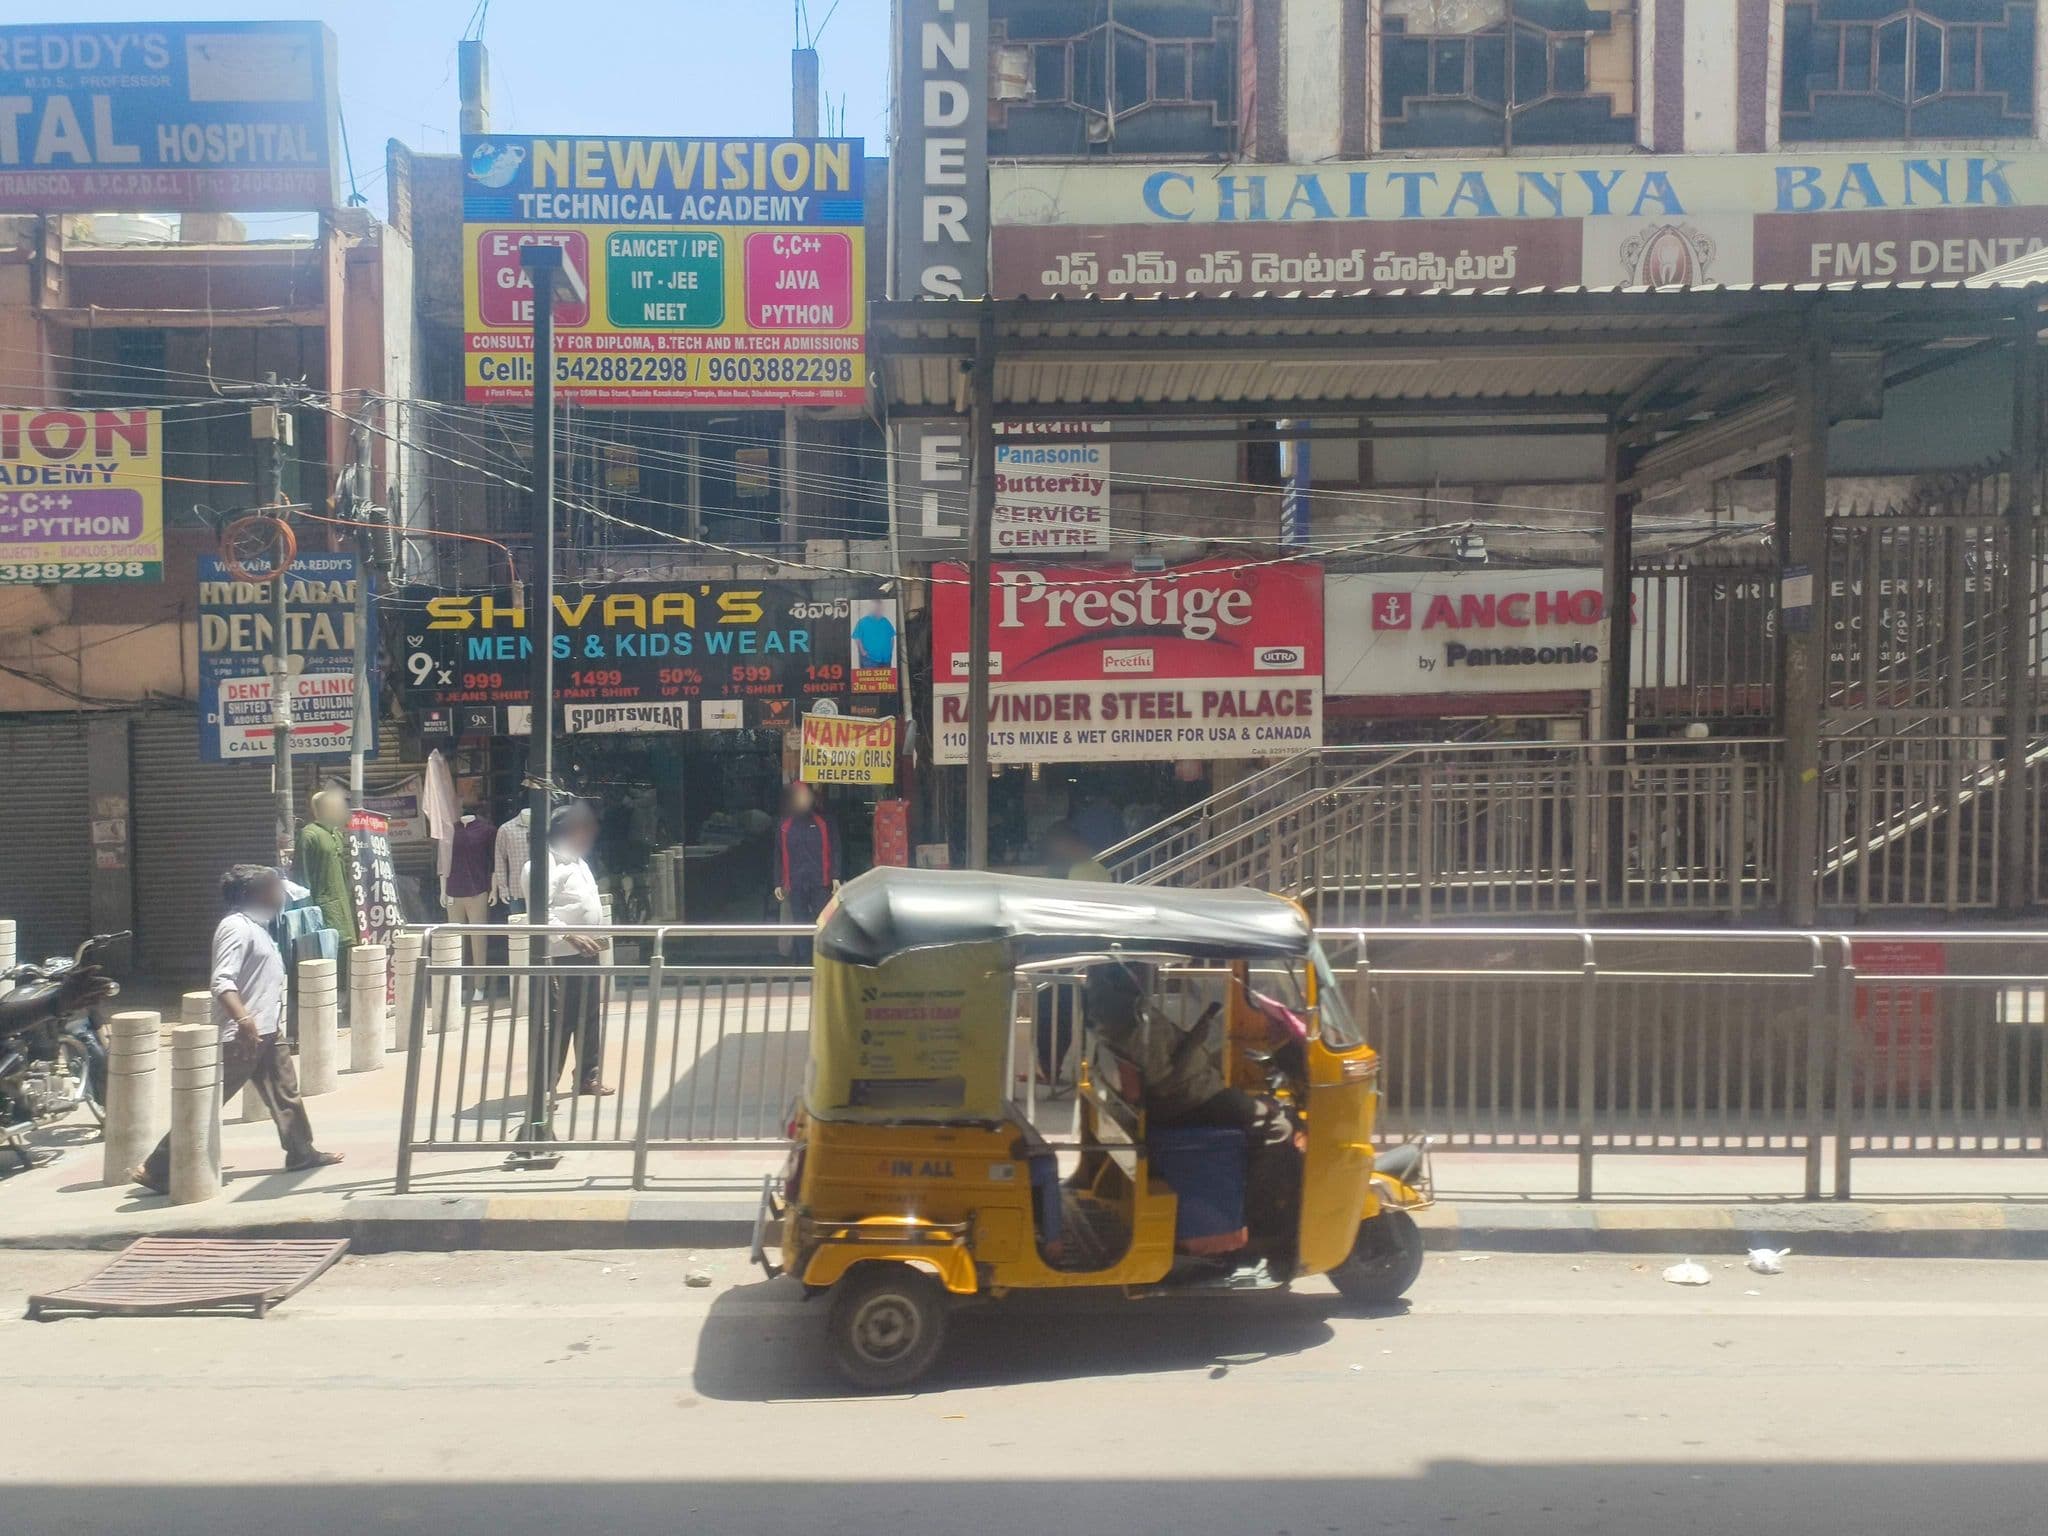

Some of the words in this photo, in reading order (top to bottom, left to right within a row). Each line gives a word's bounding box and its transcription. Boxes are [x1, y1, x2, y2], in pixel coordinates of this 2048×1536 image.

[80, 75, 172, 88] PROFESSOR
[157, 122, 318, 163] HOSPITAL
[531, 139, 852, 192] NEWVISION
[1143, 169, 1688, 222] CHAITANYA
[1773, 158, 2020, 212] BANK
[518, 193, 672, 220] TECHNICAL
[680, 195, 809, 222] ACADEMY
[610, 238, 678, 258] EAMCET
[691, 238, 719, 258] IPE
[772, 237, 822, 260] C,C++
[1185, 249, 1243, 283] ఎస్
[1810, 241, 1896, 277] FMS
[631, 271, 654, 289] IIT
[667, 270, 698, 290] JEE
[775, 270, 820, 290] JAVA
[644, 303, 687, 321] NEET
[761, 305, 834, 325] PYTHON
[568, 336, 592, 349] FOR
[596, 336, 654, 351] DIPLOMA,
[658, 336, 702, 350] B.TECH
[706, 337, 731, 350] AND
[735, 337, 780, 350] M.TECH
[783, 337, 860, 350] ADMISSIONS
[479, 356, 533, 381] Cell:
[555, 357, 687, 381] 542882298
[708, 357, 852, 382] 9603882298
[1, 410, 149, 460] ION
[997, 445, 1100, 464] Panasonic
[994, 473, 1106, 497] Butterfly
[994, 505, 1101, 524] SERVICE
[22, 515, 130, 537] PYTHON
[998, 529, 1098, 547] CENTRE
[426, 586, 764, 630] SHVAA'S
[996, 570, 1253, 640] Prestige
[1421, 588, 1637, 630] ANCHO
[583, 634, 606, 658] &
[615, 631, 693, 657] KIDS
[704, 630, 811, 655] WEAR
[1104, 655, 1151, 668] Preethi
[1263, 652, 1296, 662] ULTRA
[1418, 655, 1436, 671] by
[1446, 641, 1599, 668] Panasonic
[463, 672, 503, 689] 999
[571, 669, 623, 686] 1499
[658, 668, 703, 684] 50%
[731, 665, 772, 682] 599
[806, 664, 844, 680] 149
[446, 691, 488, 702] JEANS
[563, 688, 597, 698] PANT
[601, 687, 640, 697] SHIRT
[661, 687, 679, 696] UP
[684, 687, 700, 696] TO
[803, 682, 846, 694] SHORT
[228, 701, 267, 715] SHIFTED
[1101, 691, 1193, 721] STEEL
[1202, 688, 1313, 718] PALACE
[571, 706, 684, 734] SPORTSWEAR
[804, 719, 893, 748] WANTED
[942, 732, 967, 747] 110
[1019, 731, 1058, 745] MIXIE
[1063, 730, 1073, 744] &
[1077, 730, 1107, 744] WET
[1111, 728, 1173, 743] GRINDER
[1177, 728, 1204, 742] FOR
[1208, 727, 1236, 741] USA
[1241, 727, 1250, 740] &
[1255, 726, 1312, 740] CANADA
[229, 742, 268, 752] CALL
[803, 749, 828, 767] ALES
[830, 750, 856, 767] BOYS
[864, 749, 892, 768] GIRLS
[817, 768, 871, 781] HELPERS
